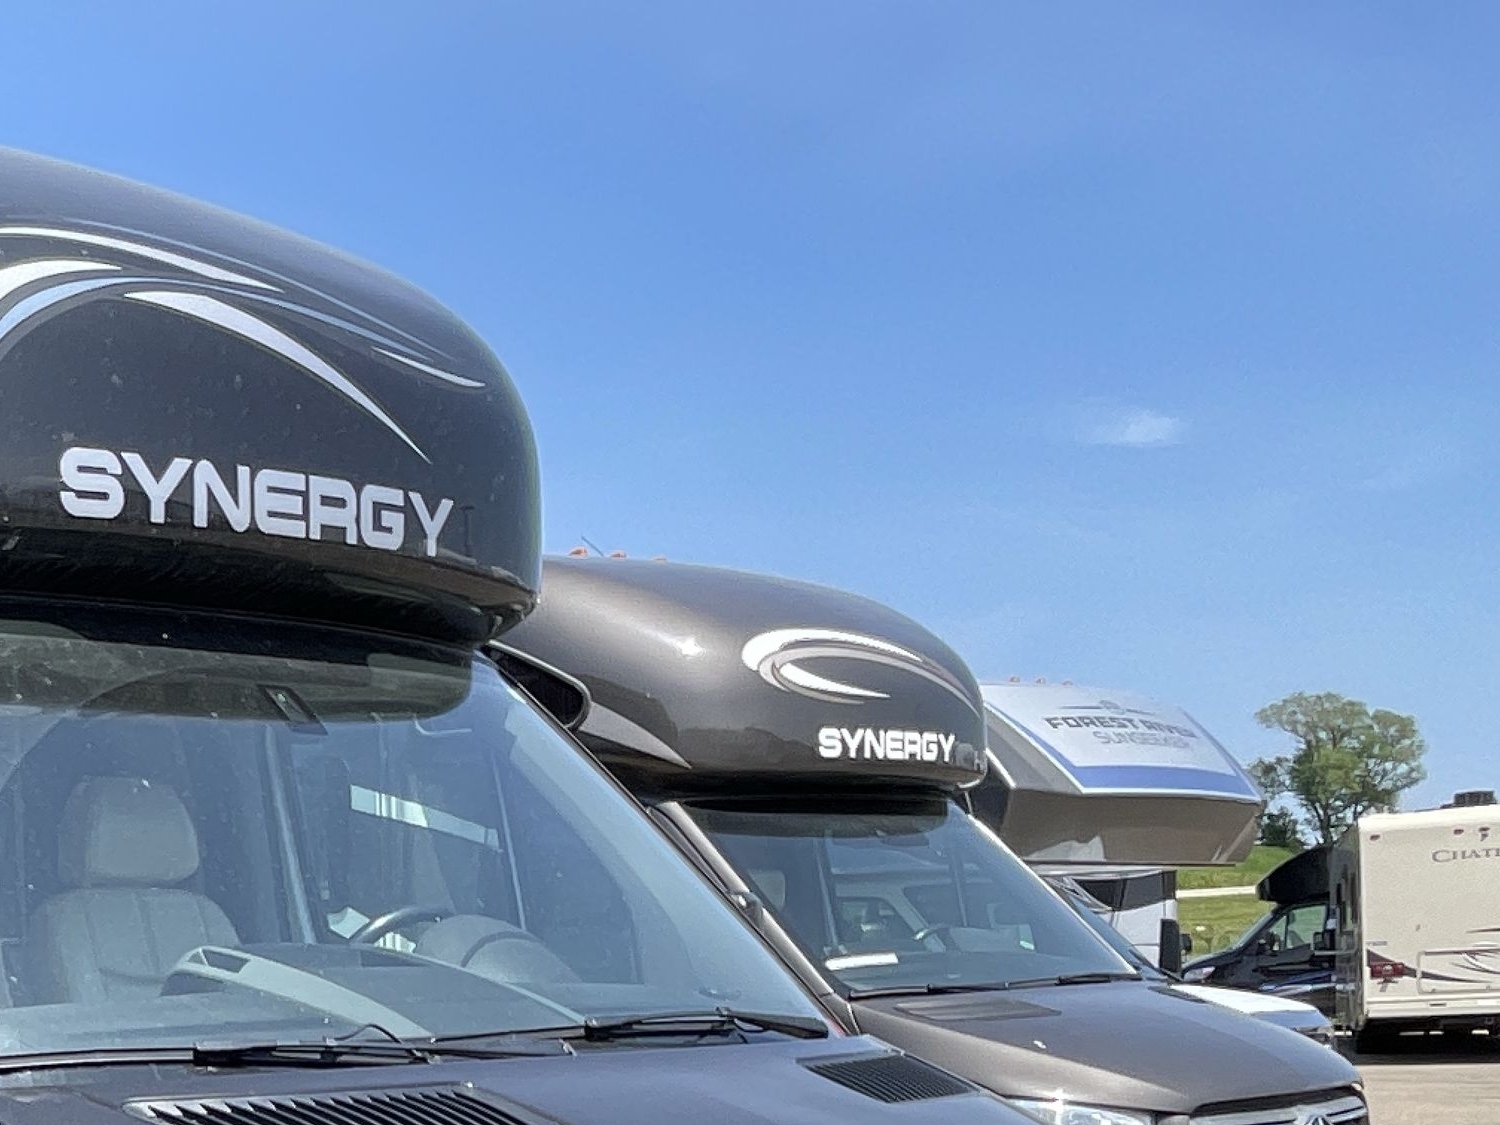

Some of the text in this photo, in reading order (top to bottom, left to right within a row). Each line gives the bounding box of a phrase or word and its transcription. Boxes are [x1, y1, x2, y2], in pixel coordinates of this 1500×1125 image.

[59, 446, 455, 557] SYNERGY
[1044, 716, 1140, 730] FOREST
[818, 727, 955, 763] SYNERGY
